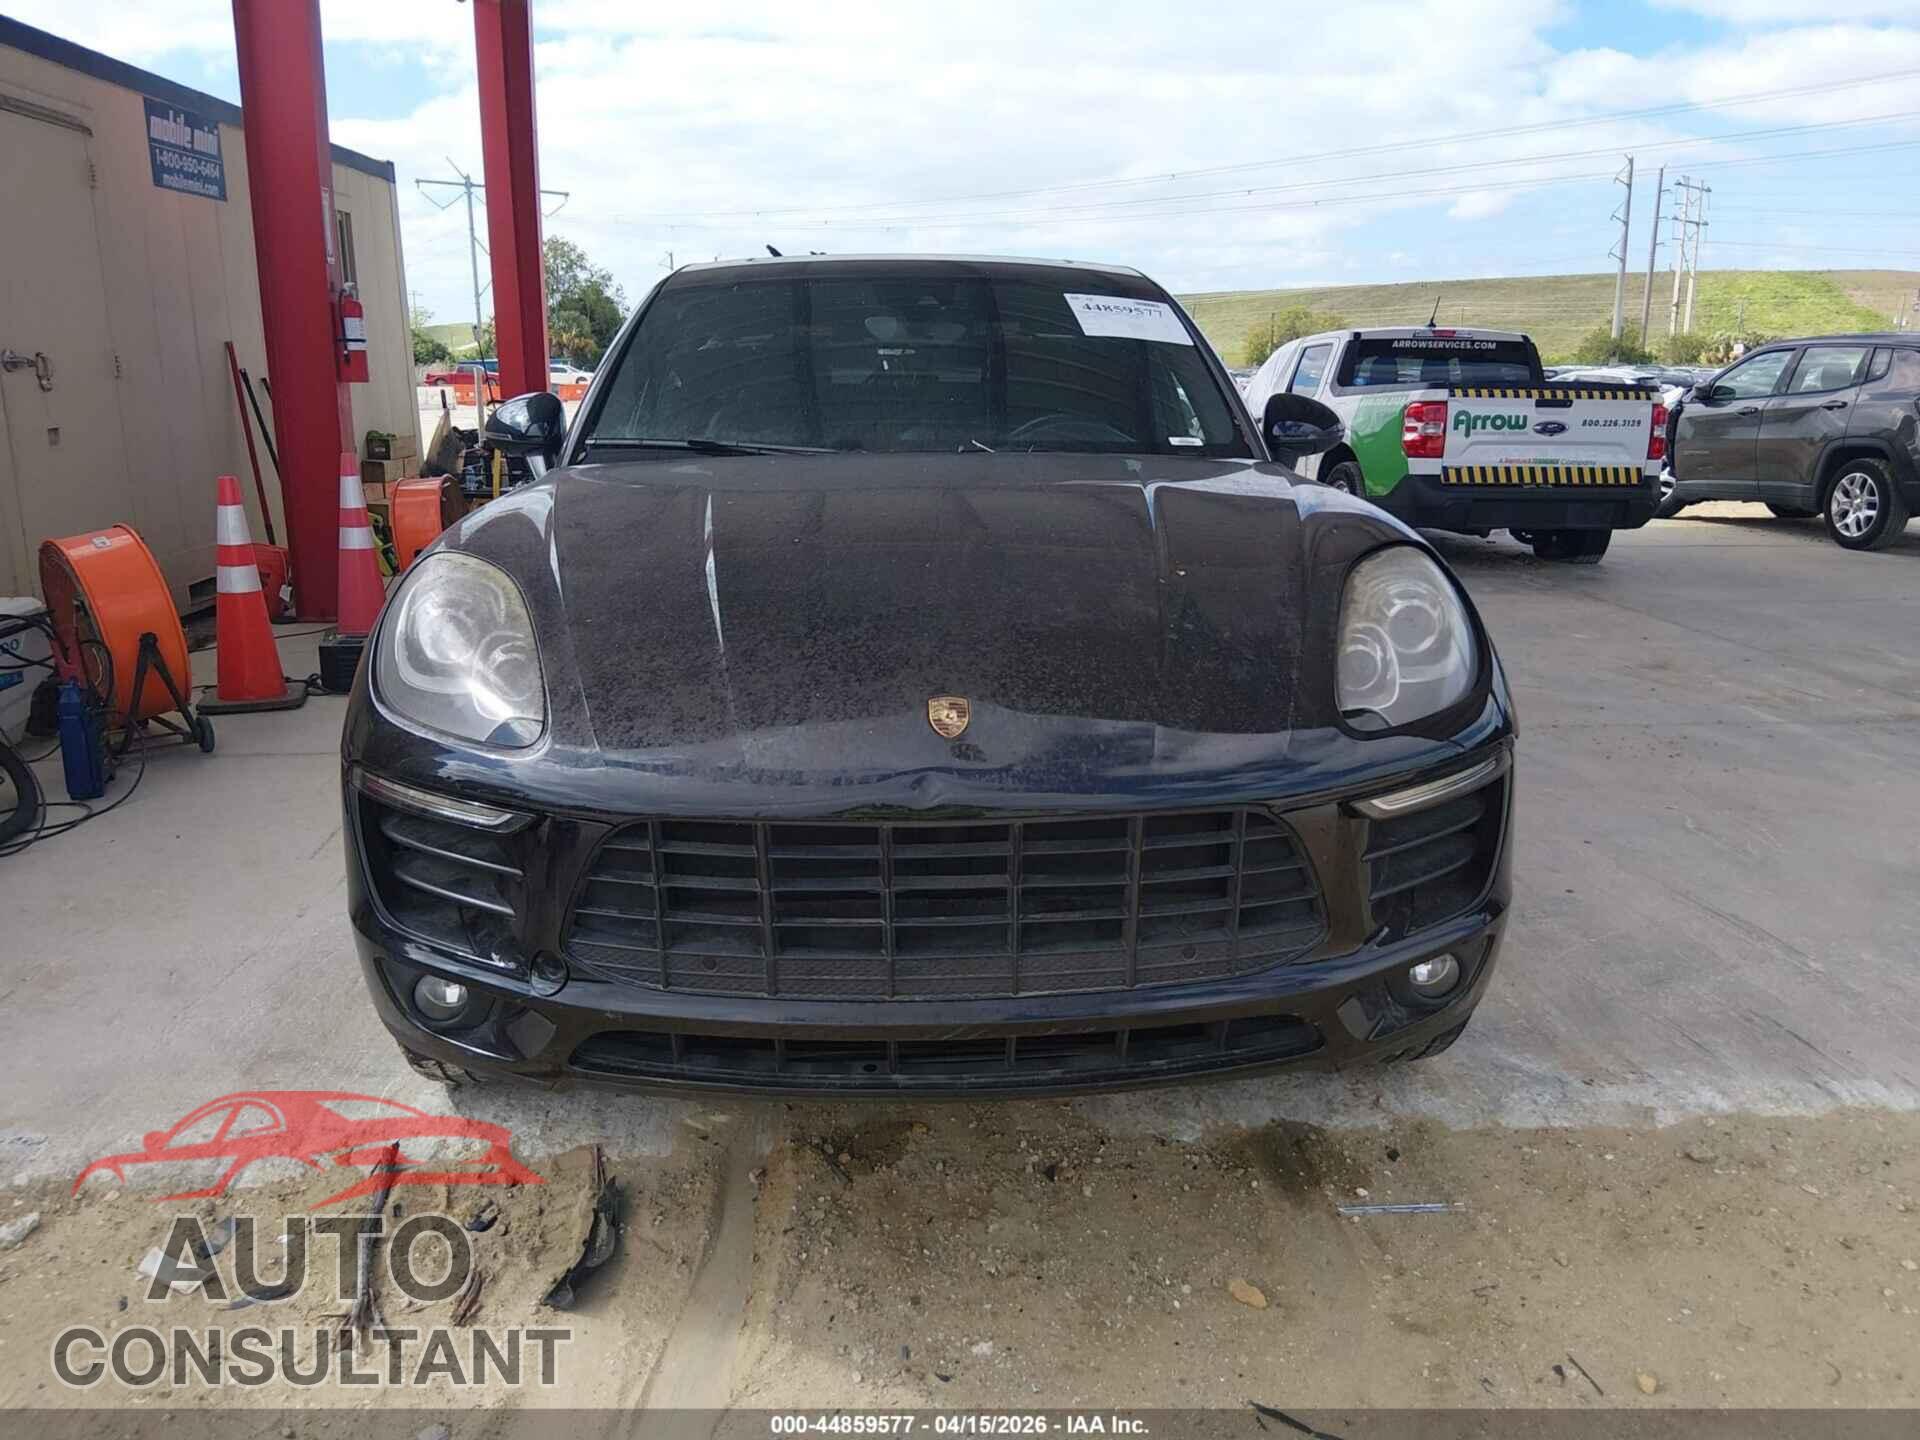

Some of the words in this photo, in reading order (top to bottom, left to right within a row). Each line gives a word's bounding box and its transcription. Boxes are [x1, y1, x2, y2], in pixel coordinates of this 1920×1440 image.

[150, 110, 192, 149] mobile
[193, 125, 219, 155] mini
[162, 172, 219, 198] mobilemini.com
[1082, 303, 1162, 318] 44859577
[1391, 340, 1497, 350] ARROWSERVICES.COM
[1453, 410, 1528, 438] Arrow
